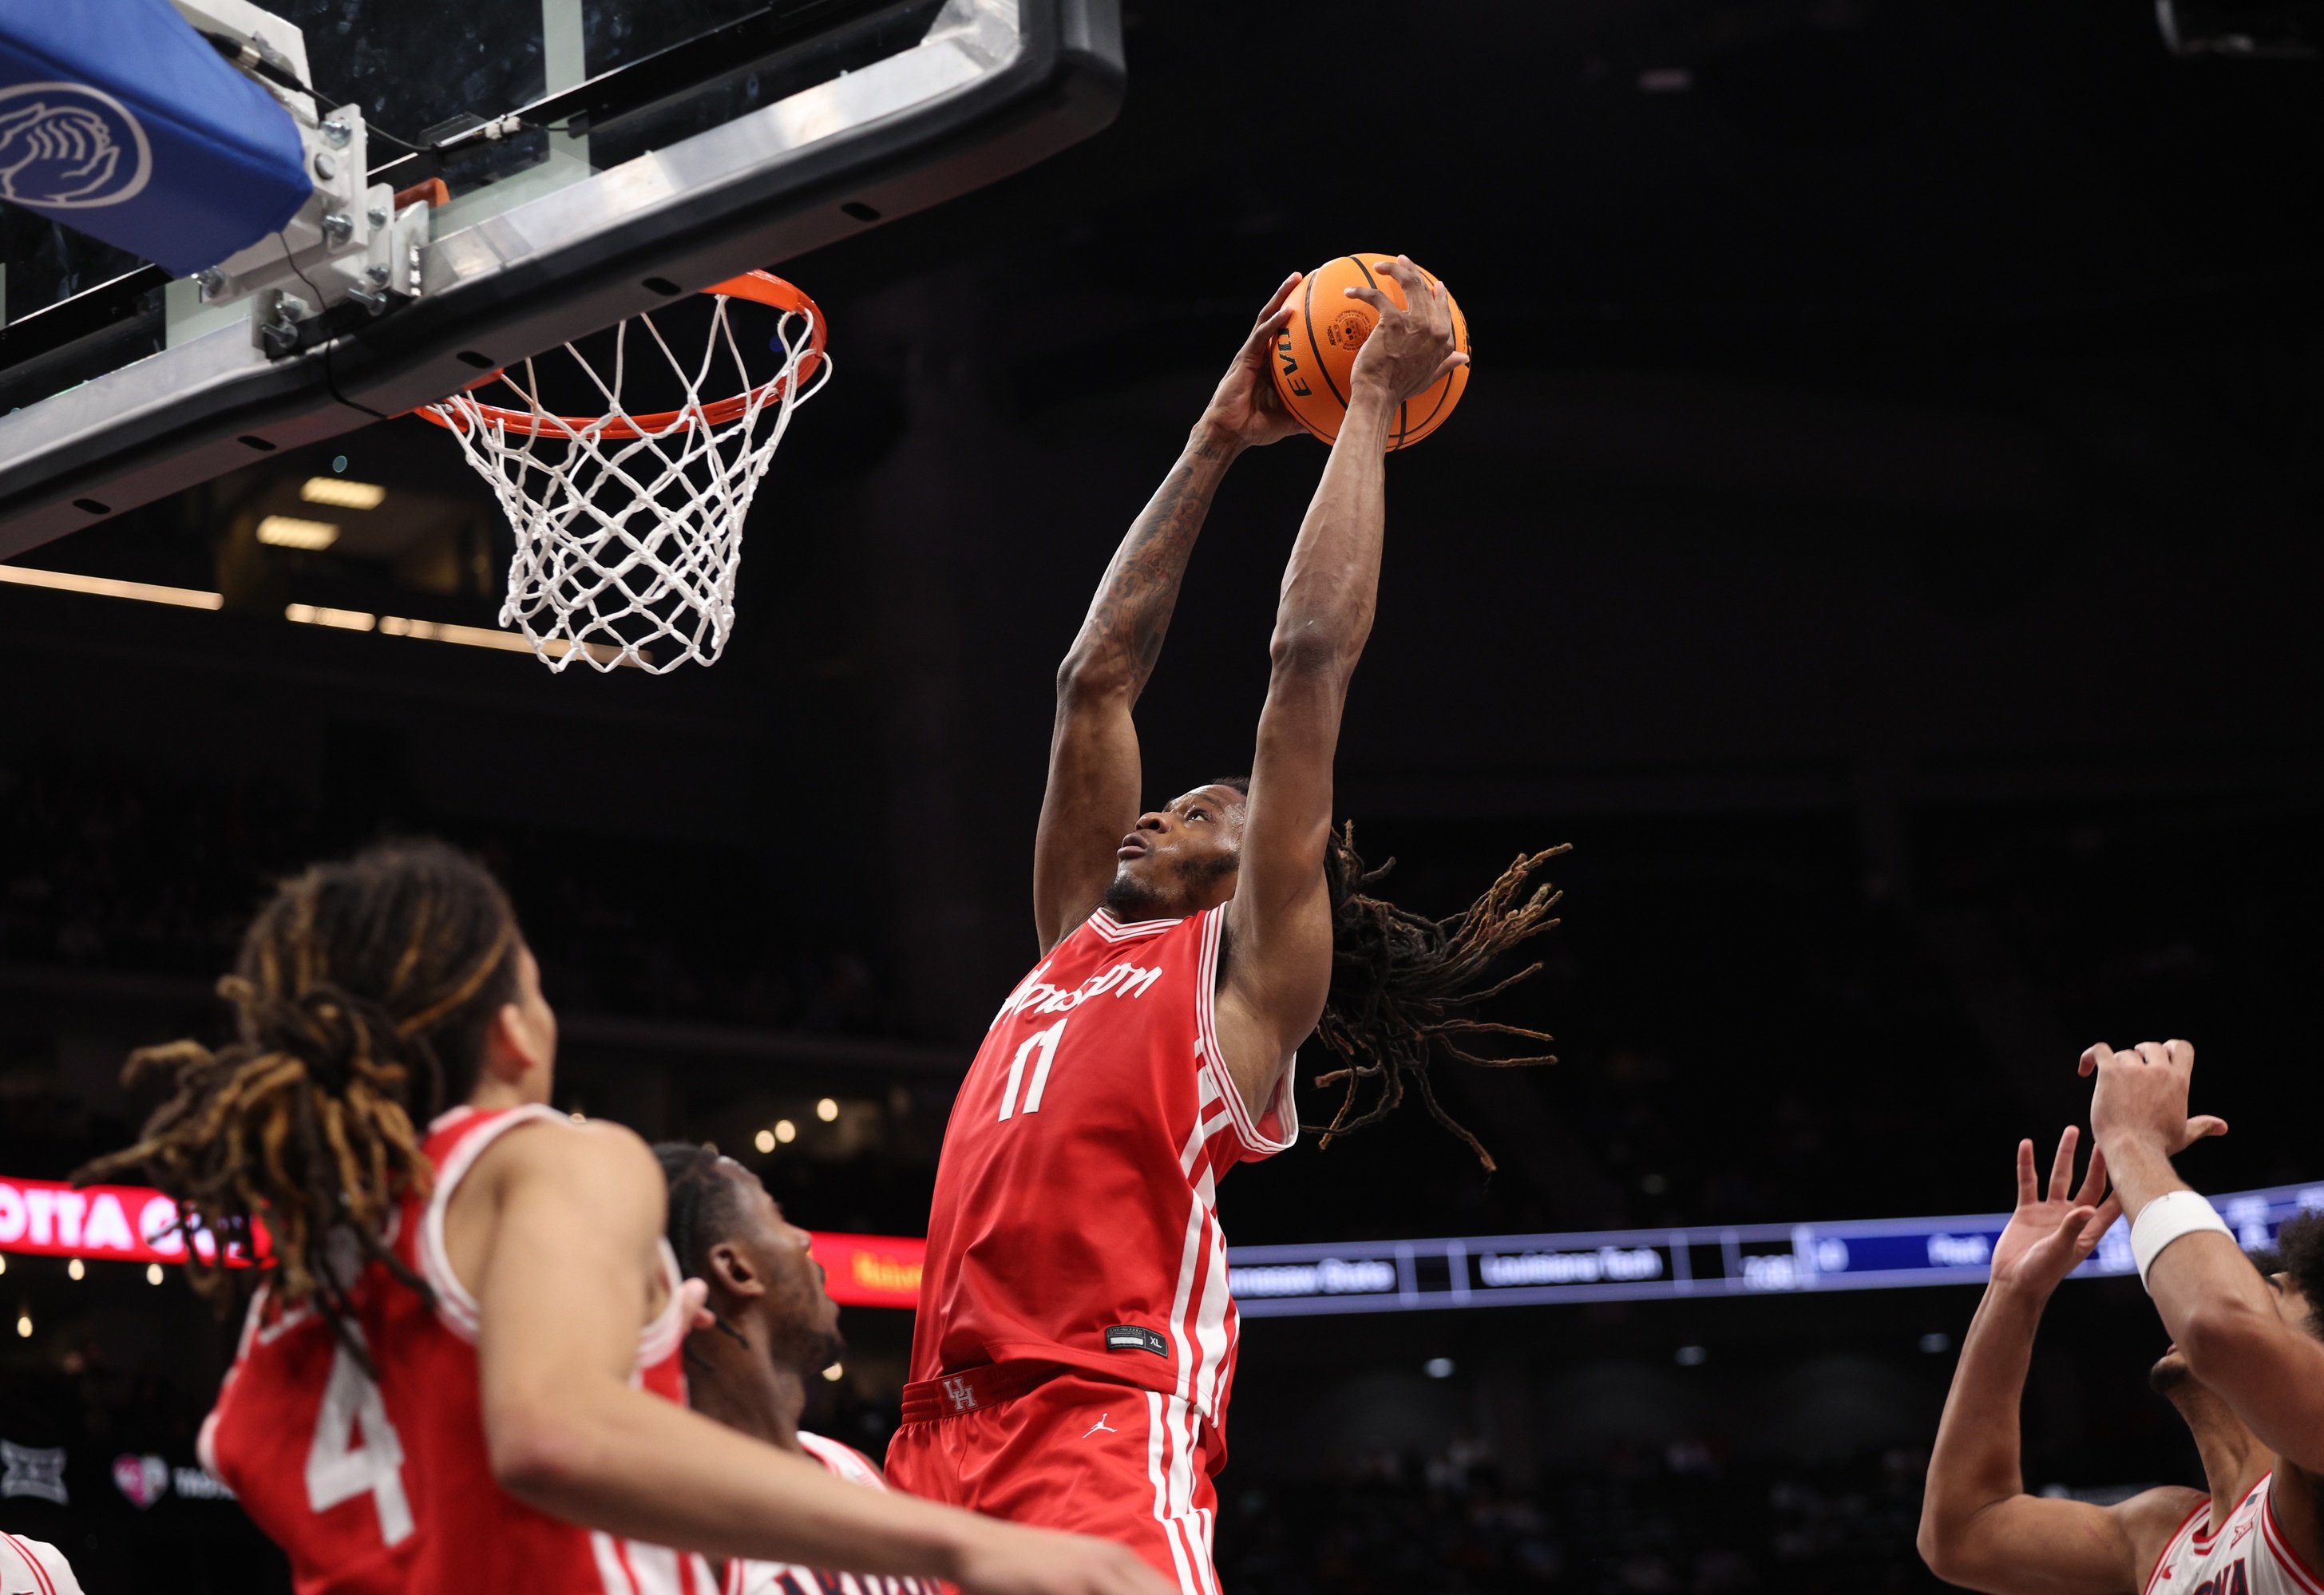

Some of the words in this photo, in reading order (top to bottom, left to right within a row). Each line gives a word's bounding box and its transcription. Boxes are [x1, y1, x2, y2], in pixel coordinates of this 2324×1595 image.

[1277, 328, 1312, 397] EVO
[998, 1018, 1068, 1122] 11
[1150, 1336, 1162, 1348] XL
[944, 1377, 977, 1411] UH
[305, 1319, 415, 1547] 4
